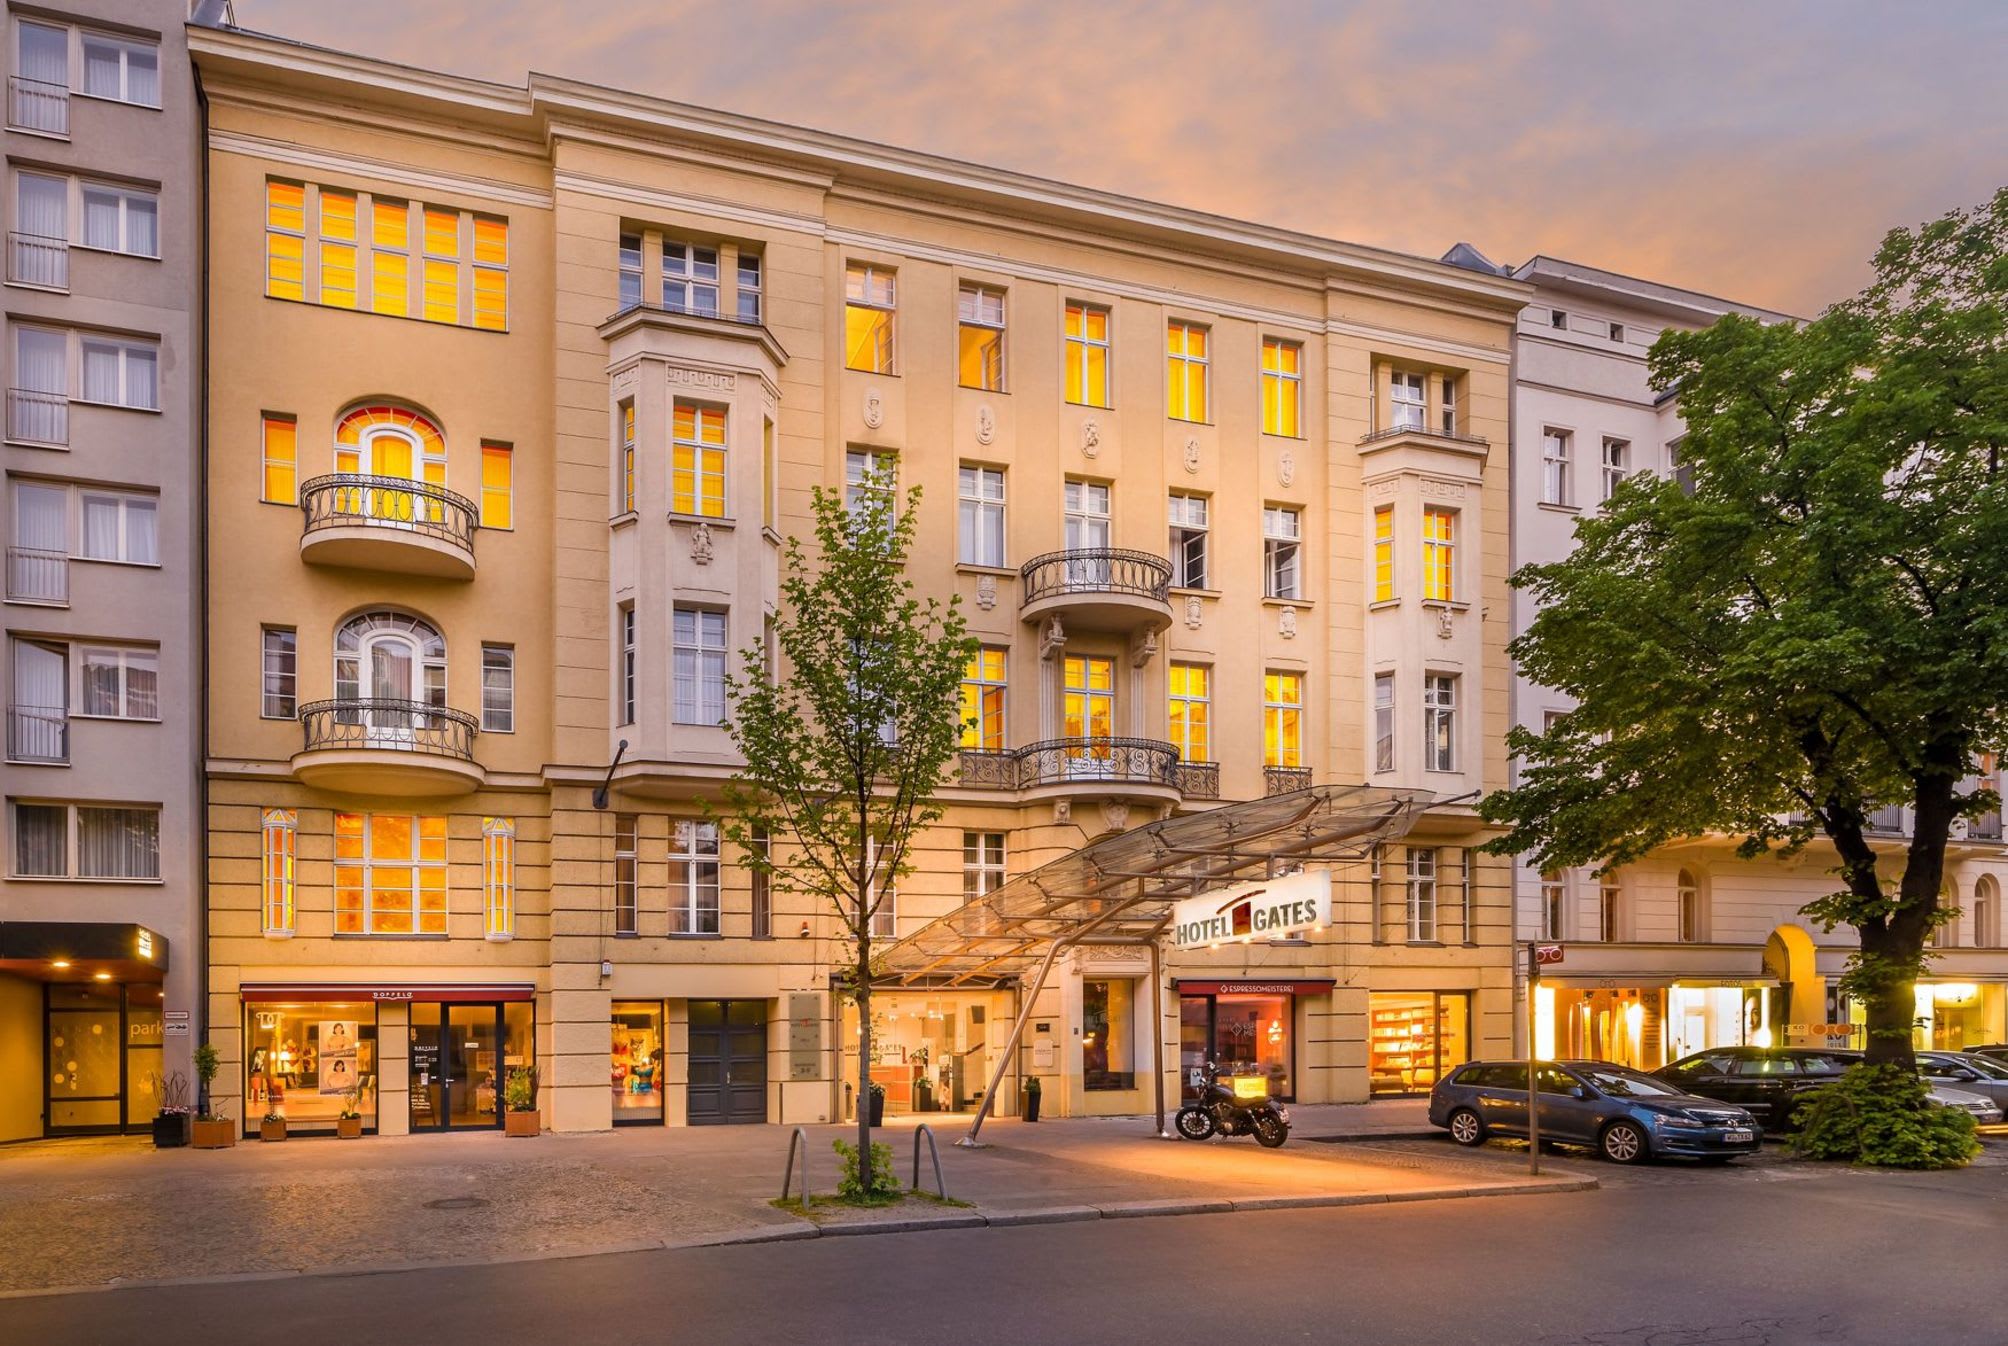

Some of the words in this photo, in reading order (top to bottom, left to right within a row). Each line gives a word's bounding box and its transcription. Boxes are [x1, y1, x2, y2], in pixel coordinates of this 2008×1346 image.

[1176, 917, 1230, 945] HOTEL
[1253, 899, 1317, 931] GATES
[1229, 985, 1294, 993] ESPRESSOMEISTEREI
